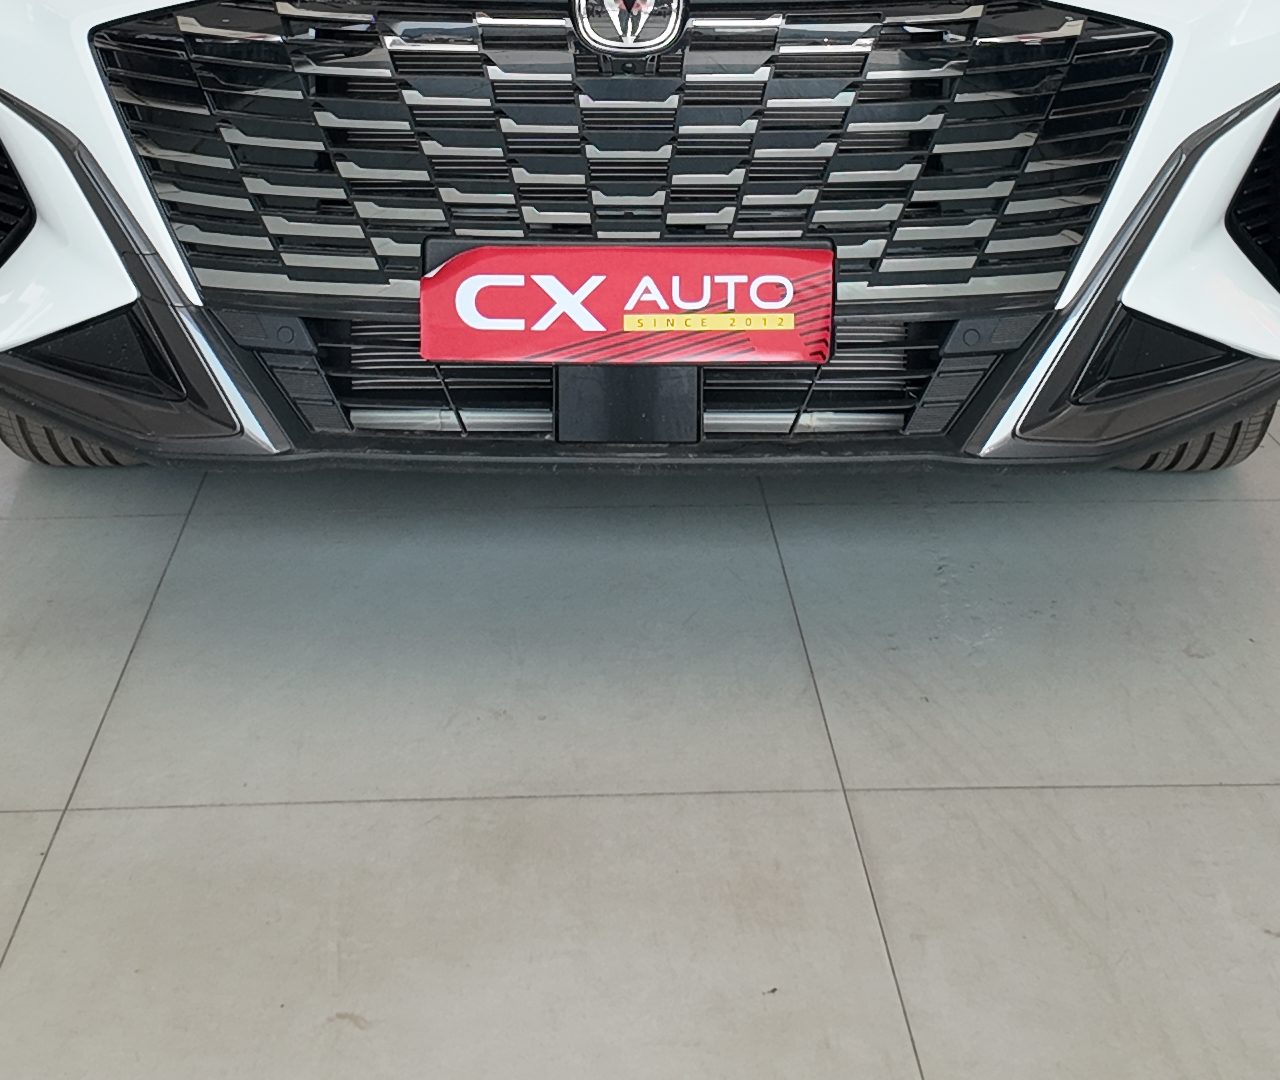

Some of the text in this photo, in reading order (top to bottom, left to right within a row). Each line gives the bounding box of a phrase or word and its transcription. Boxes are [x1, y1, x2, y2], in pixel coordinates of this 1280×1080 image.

[455, 274, 795, 331] CX AUTO
[637, 318, 785, 328] SINCE 2012
